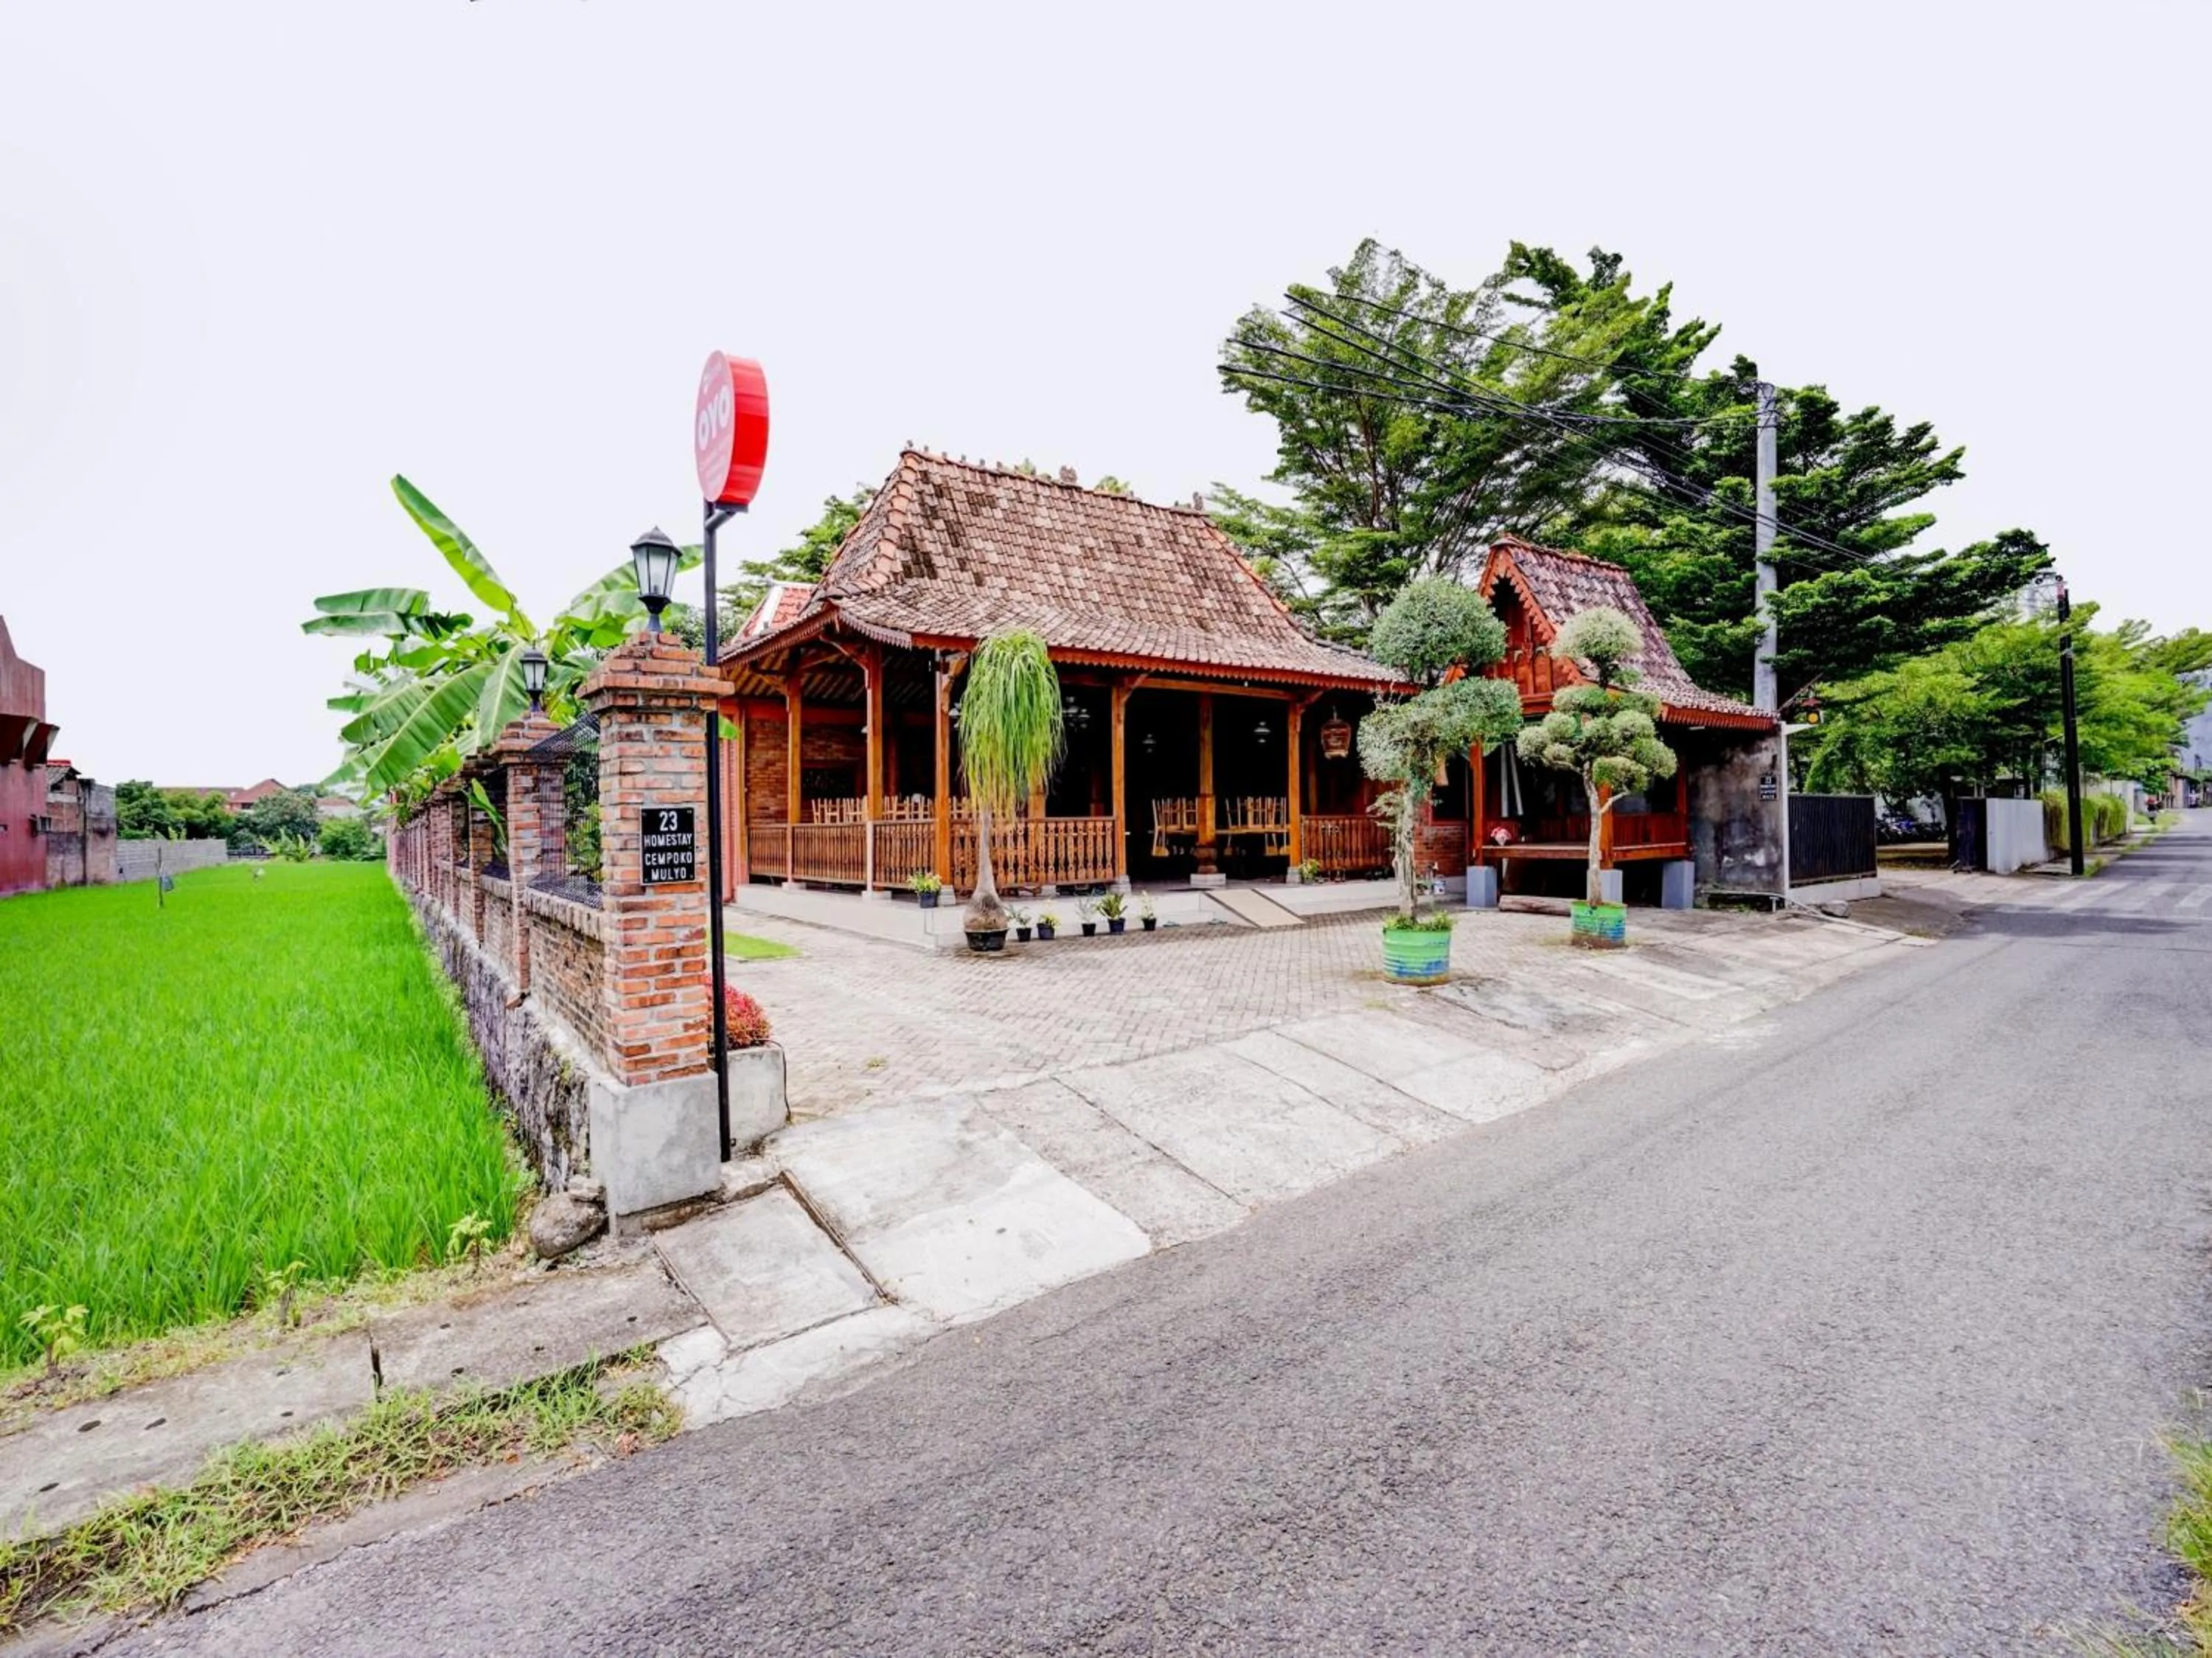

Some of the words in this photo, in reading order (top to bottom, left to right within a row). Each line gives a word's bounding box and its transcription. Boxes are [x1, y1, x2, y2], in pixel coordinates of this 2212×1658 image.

[698, 384, 730, 451] OYO
[659, 811, 678, 831] 23
[644, 833, 692, 847] HOMESTAY
[645, 852, 692, 865] CEMPOKO
[651, 867, 686, 881] MULYO
